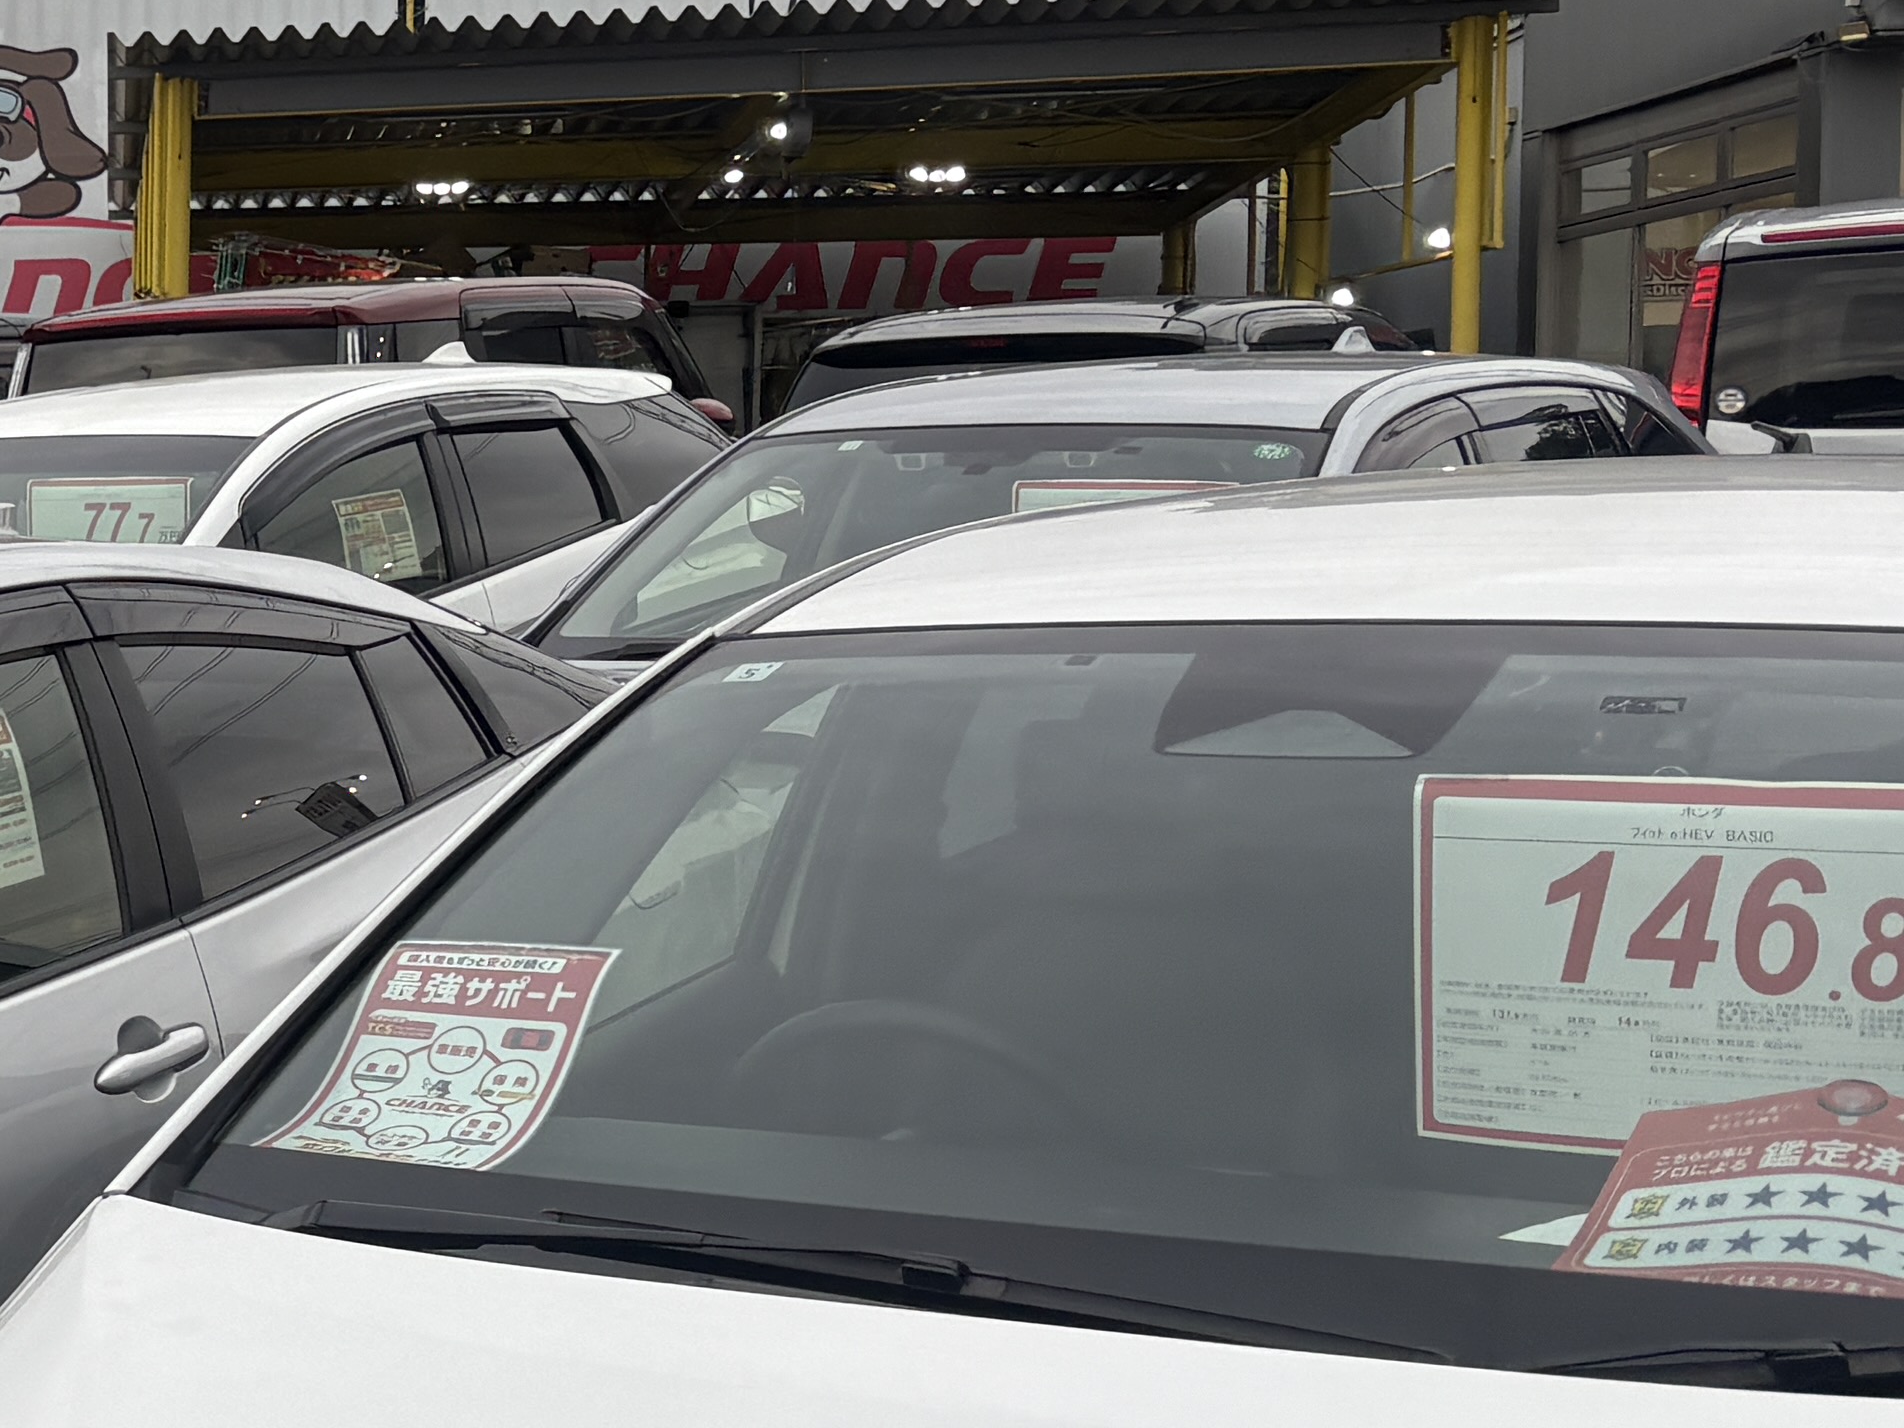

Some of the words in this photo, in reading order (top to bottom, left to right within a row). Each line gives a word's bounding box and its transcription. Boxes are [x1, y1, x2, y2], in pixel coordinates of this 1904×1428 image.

[590, 237, 1117, 310] HANCE
[1545, 850, 1904, 1002] 146.8
[382, 971, 577, 1013] 最強サポート
